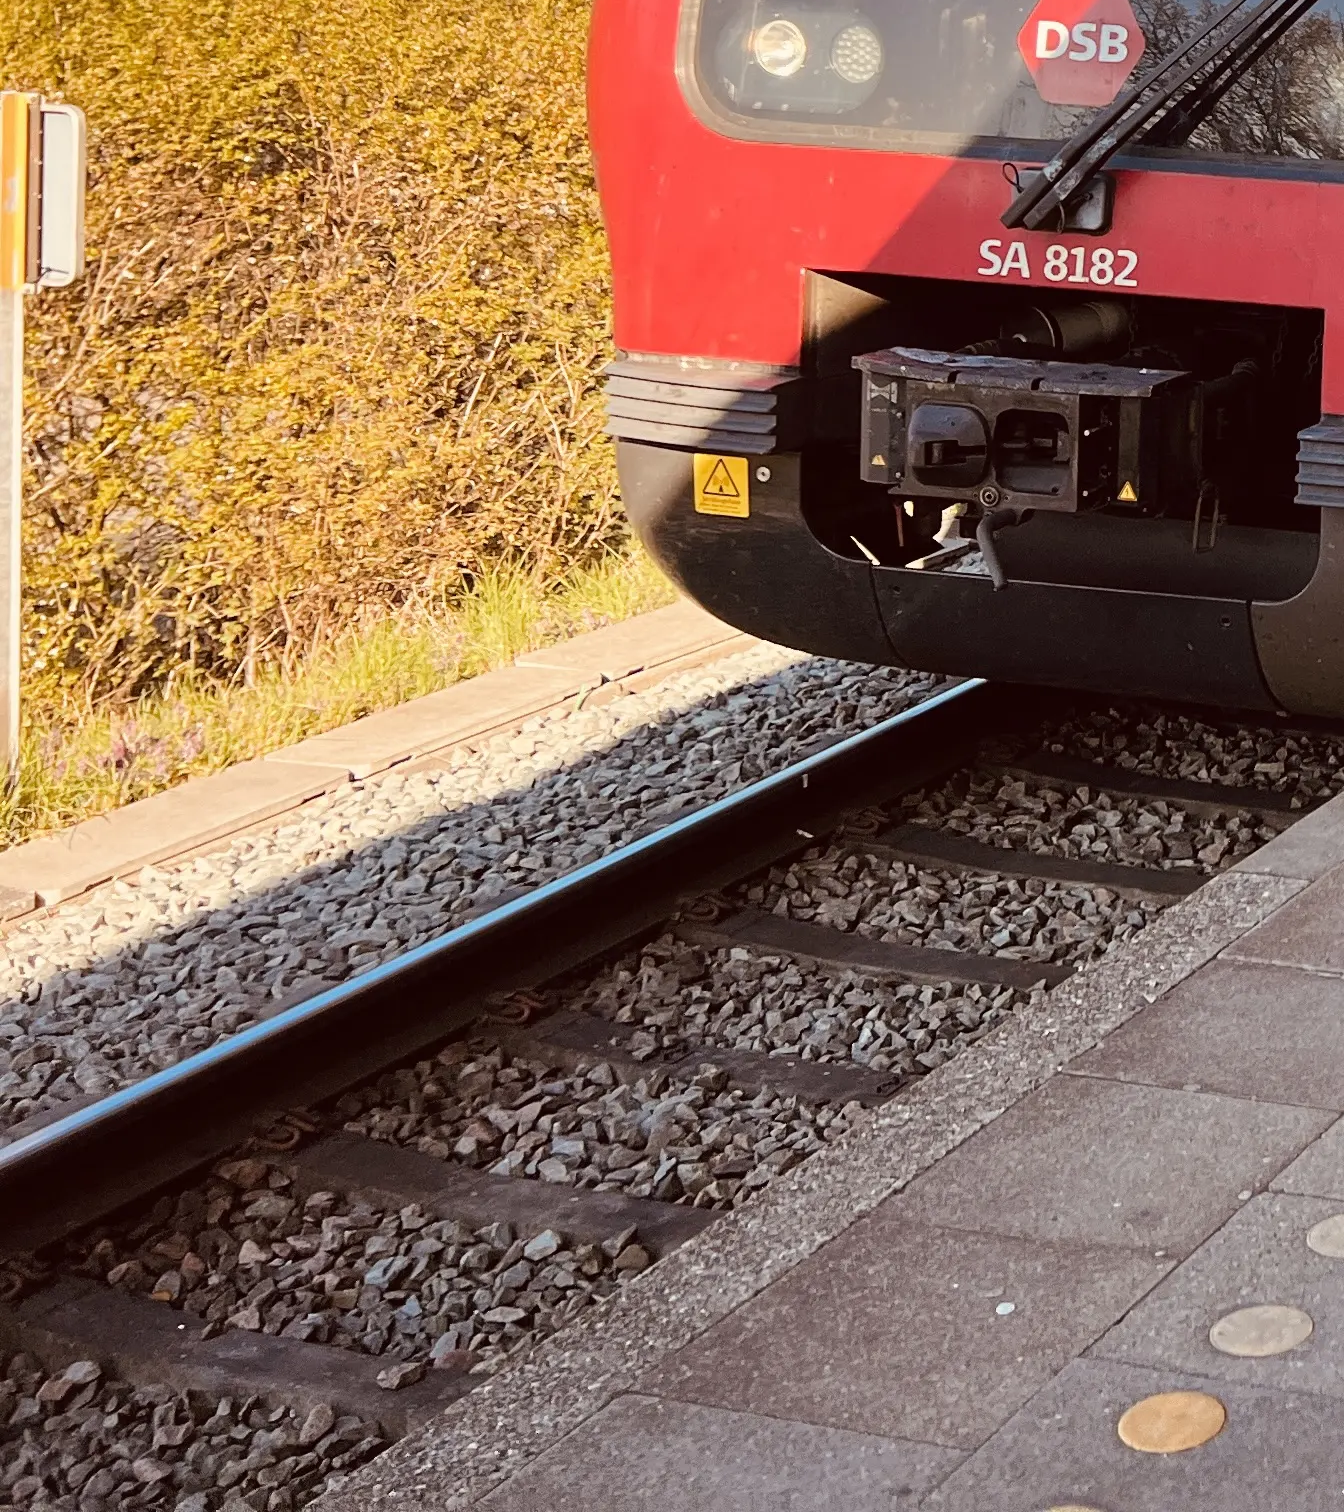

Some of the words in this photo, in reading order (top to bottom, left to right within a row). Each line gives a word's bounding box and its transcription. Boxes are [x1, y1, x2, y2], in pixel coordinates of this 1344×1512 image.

[1036, 20, 1128, 63] DSB
[977, 239, 1030, 279] SA
[1043, 244, 1138, 287] 8182
